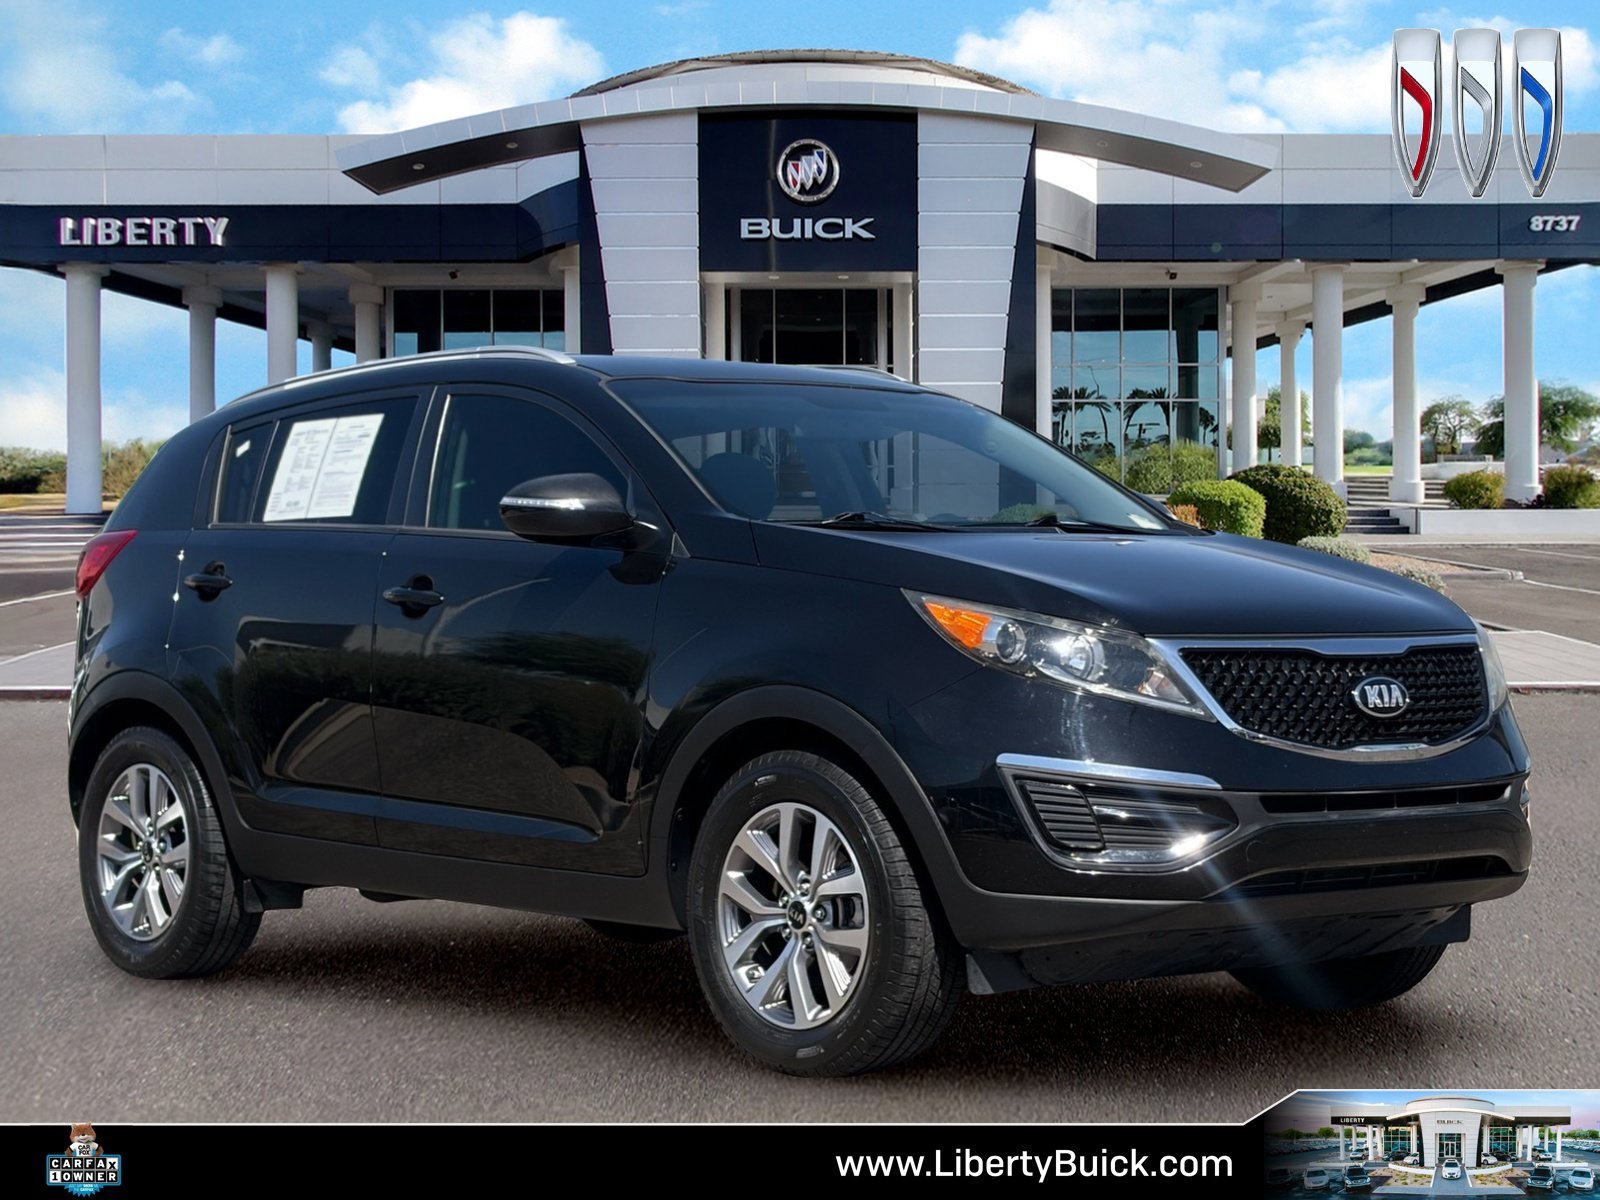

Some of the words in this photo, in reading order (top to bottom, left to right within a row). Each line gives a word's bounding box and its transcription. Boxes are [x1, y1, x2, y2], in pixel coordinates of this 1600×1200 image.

[59, 216, 230, 246] LIBERTY
[740, 218, 876, 239] BUICK
[1529, 215, 1581, 231] 8737
[1363, 684, 1404, 708] KIA
